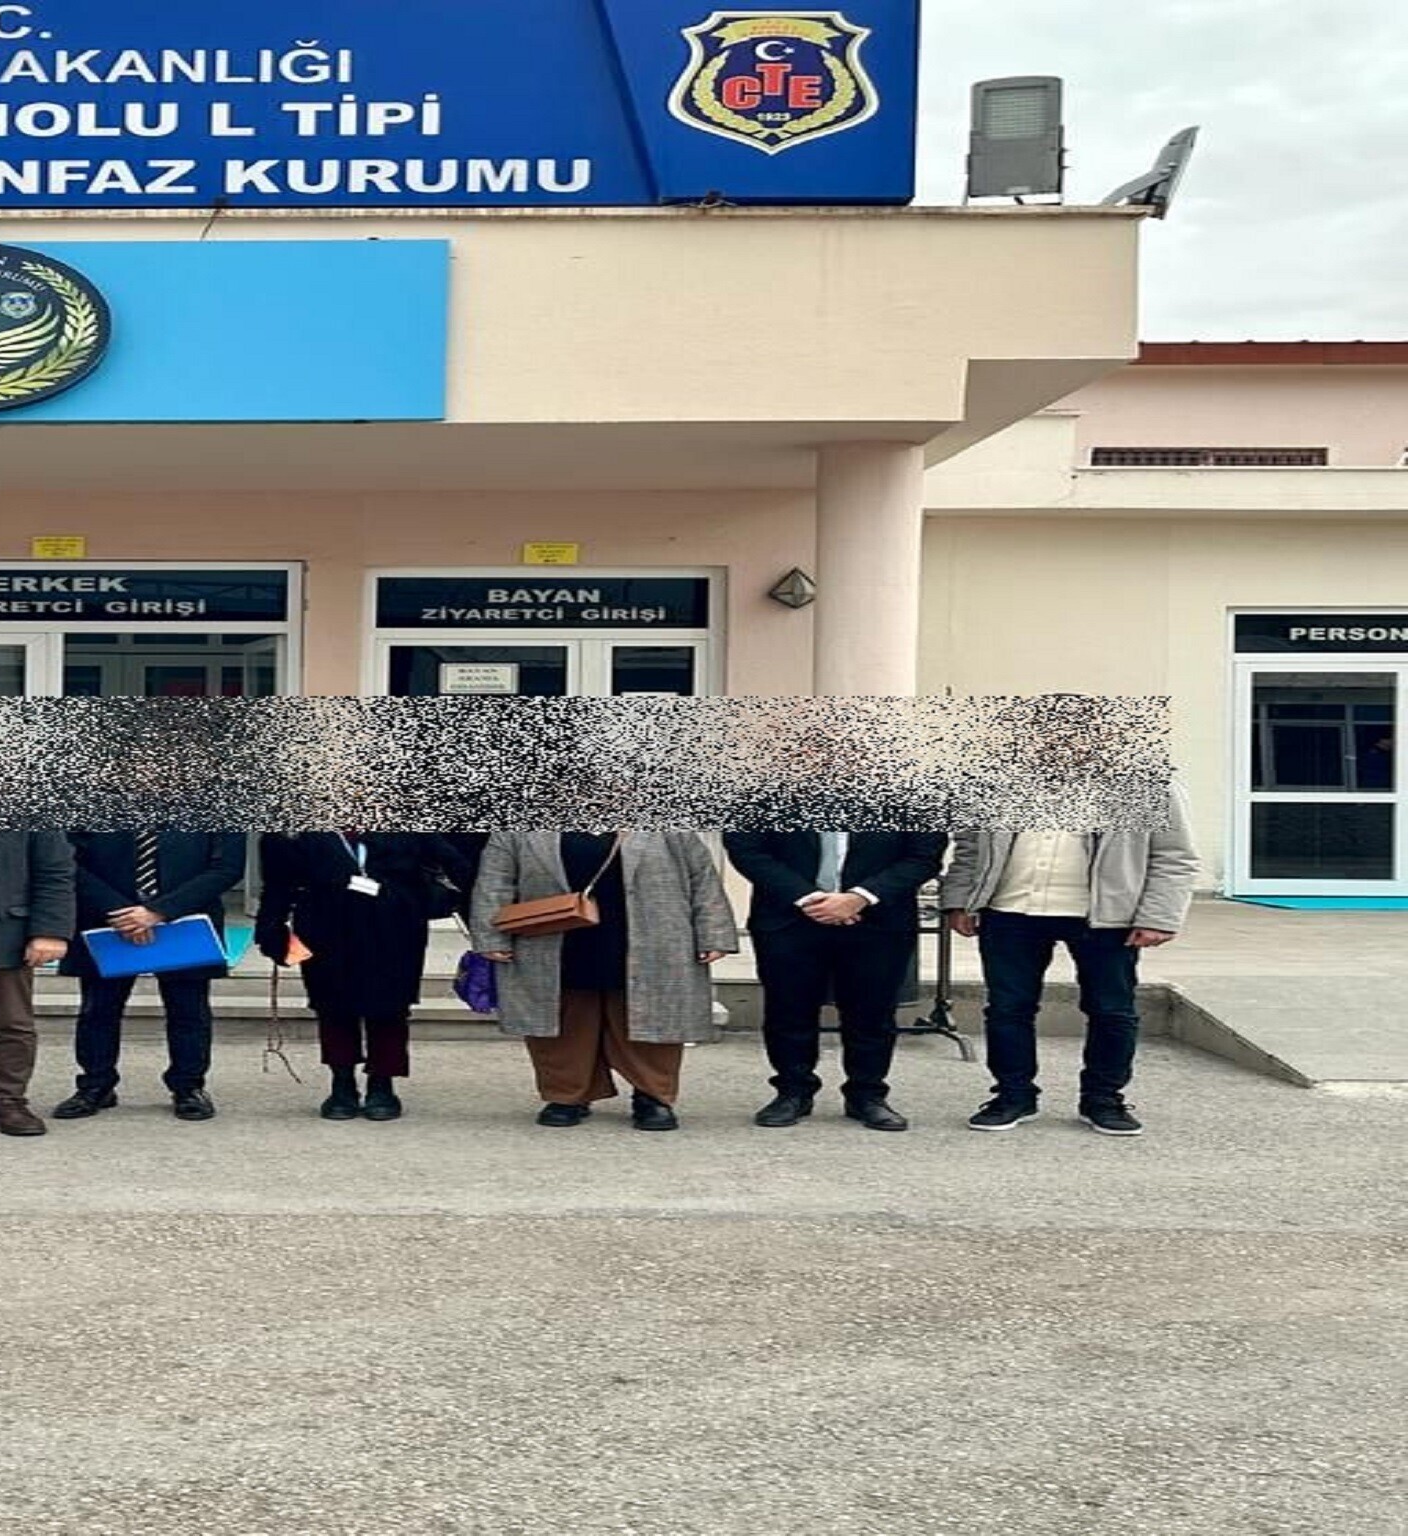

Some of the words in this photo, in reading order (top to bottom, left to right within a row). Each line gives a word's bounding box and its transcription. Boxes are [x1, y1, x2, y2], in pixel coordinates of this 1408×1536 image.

[722, 63, 823, 109] CTE
[211, 103, 254, 136] L
[281, 94, 441, 137] TİPİ
[225, 159, 591, 195] KURUMU
[105, 598, 205, 616] GİRİŞİ
[488, 589, 600, 603] BAYAN
[580, 606, 666, 622] GİRİŞİ
